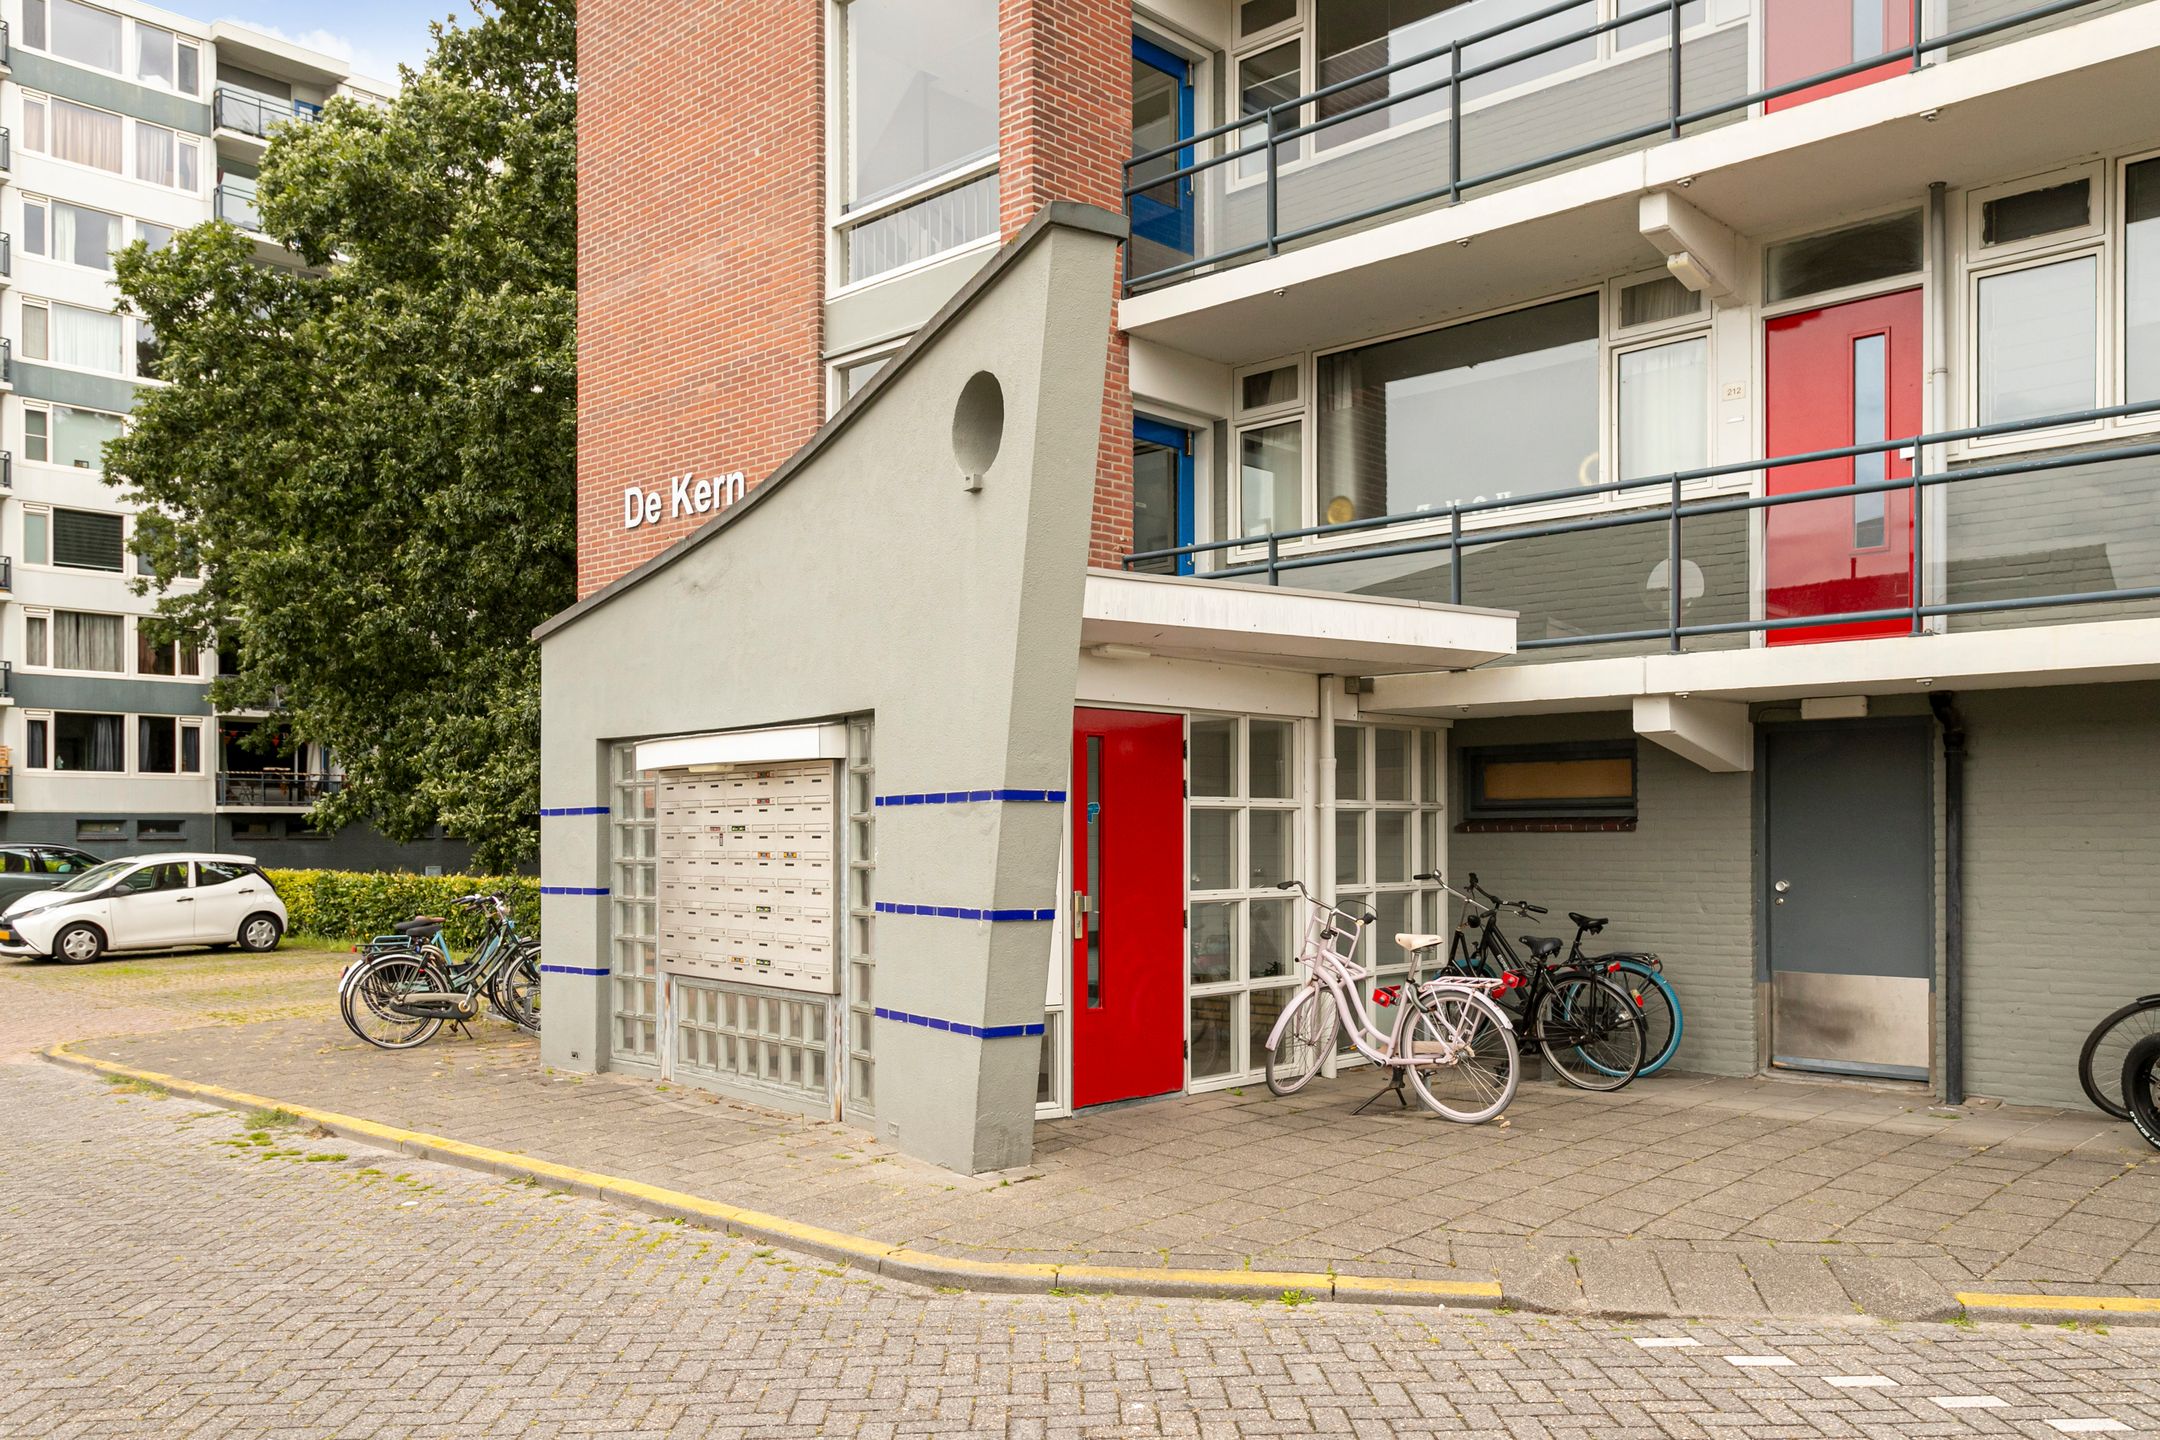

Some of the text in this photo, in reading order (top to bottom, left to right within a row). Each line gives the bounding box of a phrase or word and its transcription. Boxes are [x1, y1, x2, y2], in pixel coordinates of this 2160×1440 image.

[1727, 386, 1742, 396] 212
[624, 471, 745, 529] De Kern
